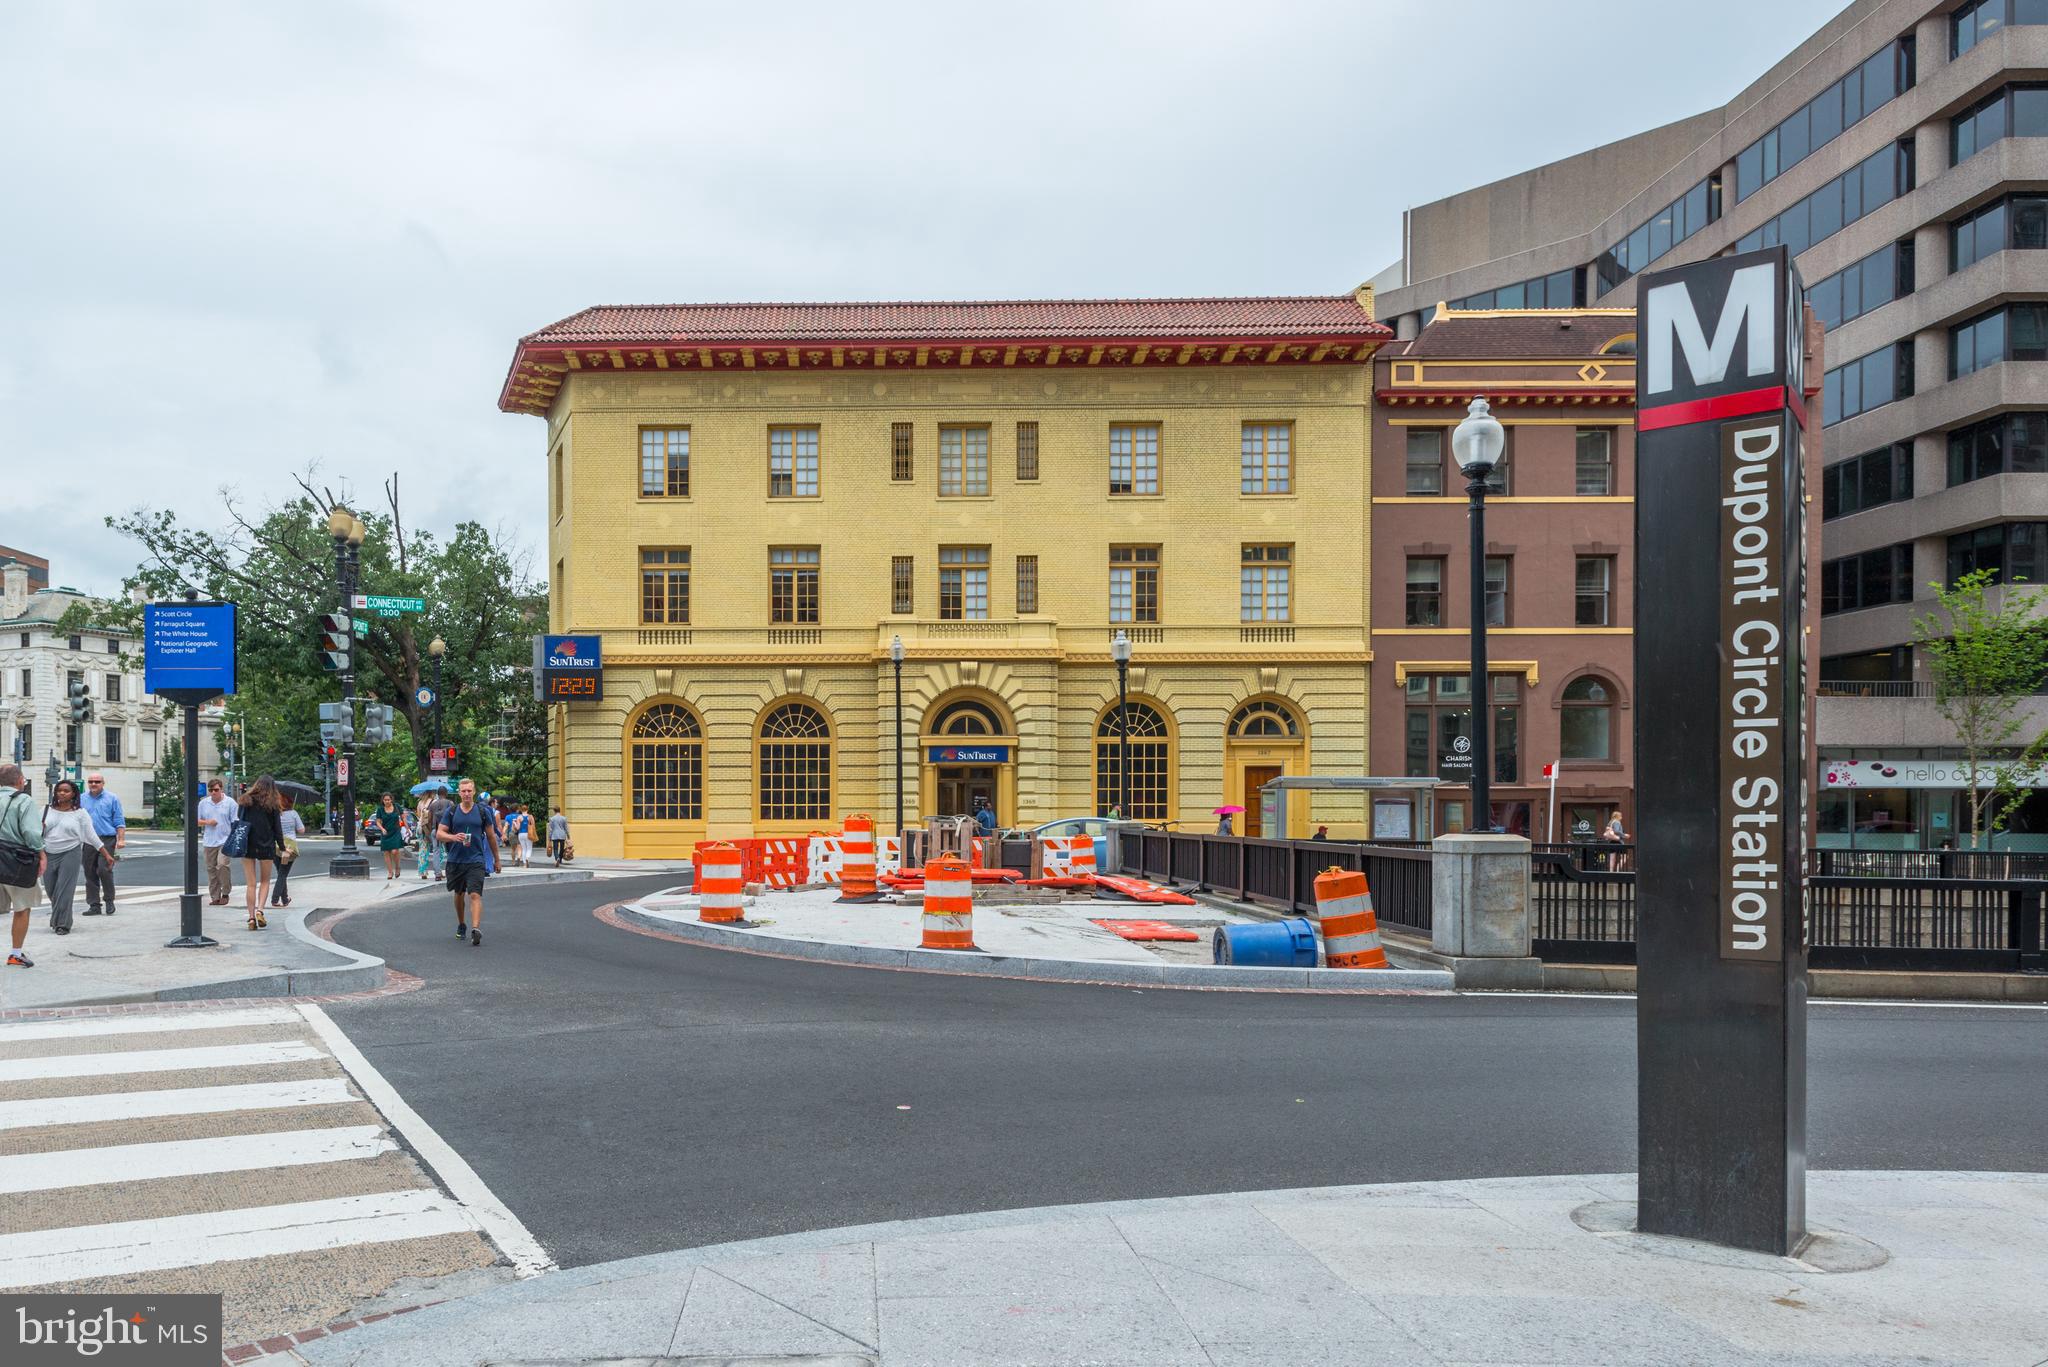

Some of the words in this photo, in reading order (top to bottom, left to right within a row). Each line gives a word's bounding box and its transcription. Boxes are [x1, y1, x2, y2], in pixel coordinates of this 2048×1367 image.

[1648, 262, 1775, 395] M
[1723, 425, 1780, 605] Dupont
[367, 597, 416, 609] CONNECTICUT
[379, 608, 400, 617] 1300
[552, 678, 595, 694] 12:29
[1732, 620, 1779, 759] Circle
[1905, 762, 1946, 781] hello
[1731, 776, 1779, 950] Station
